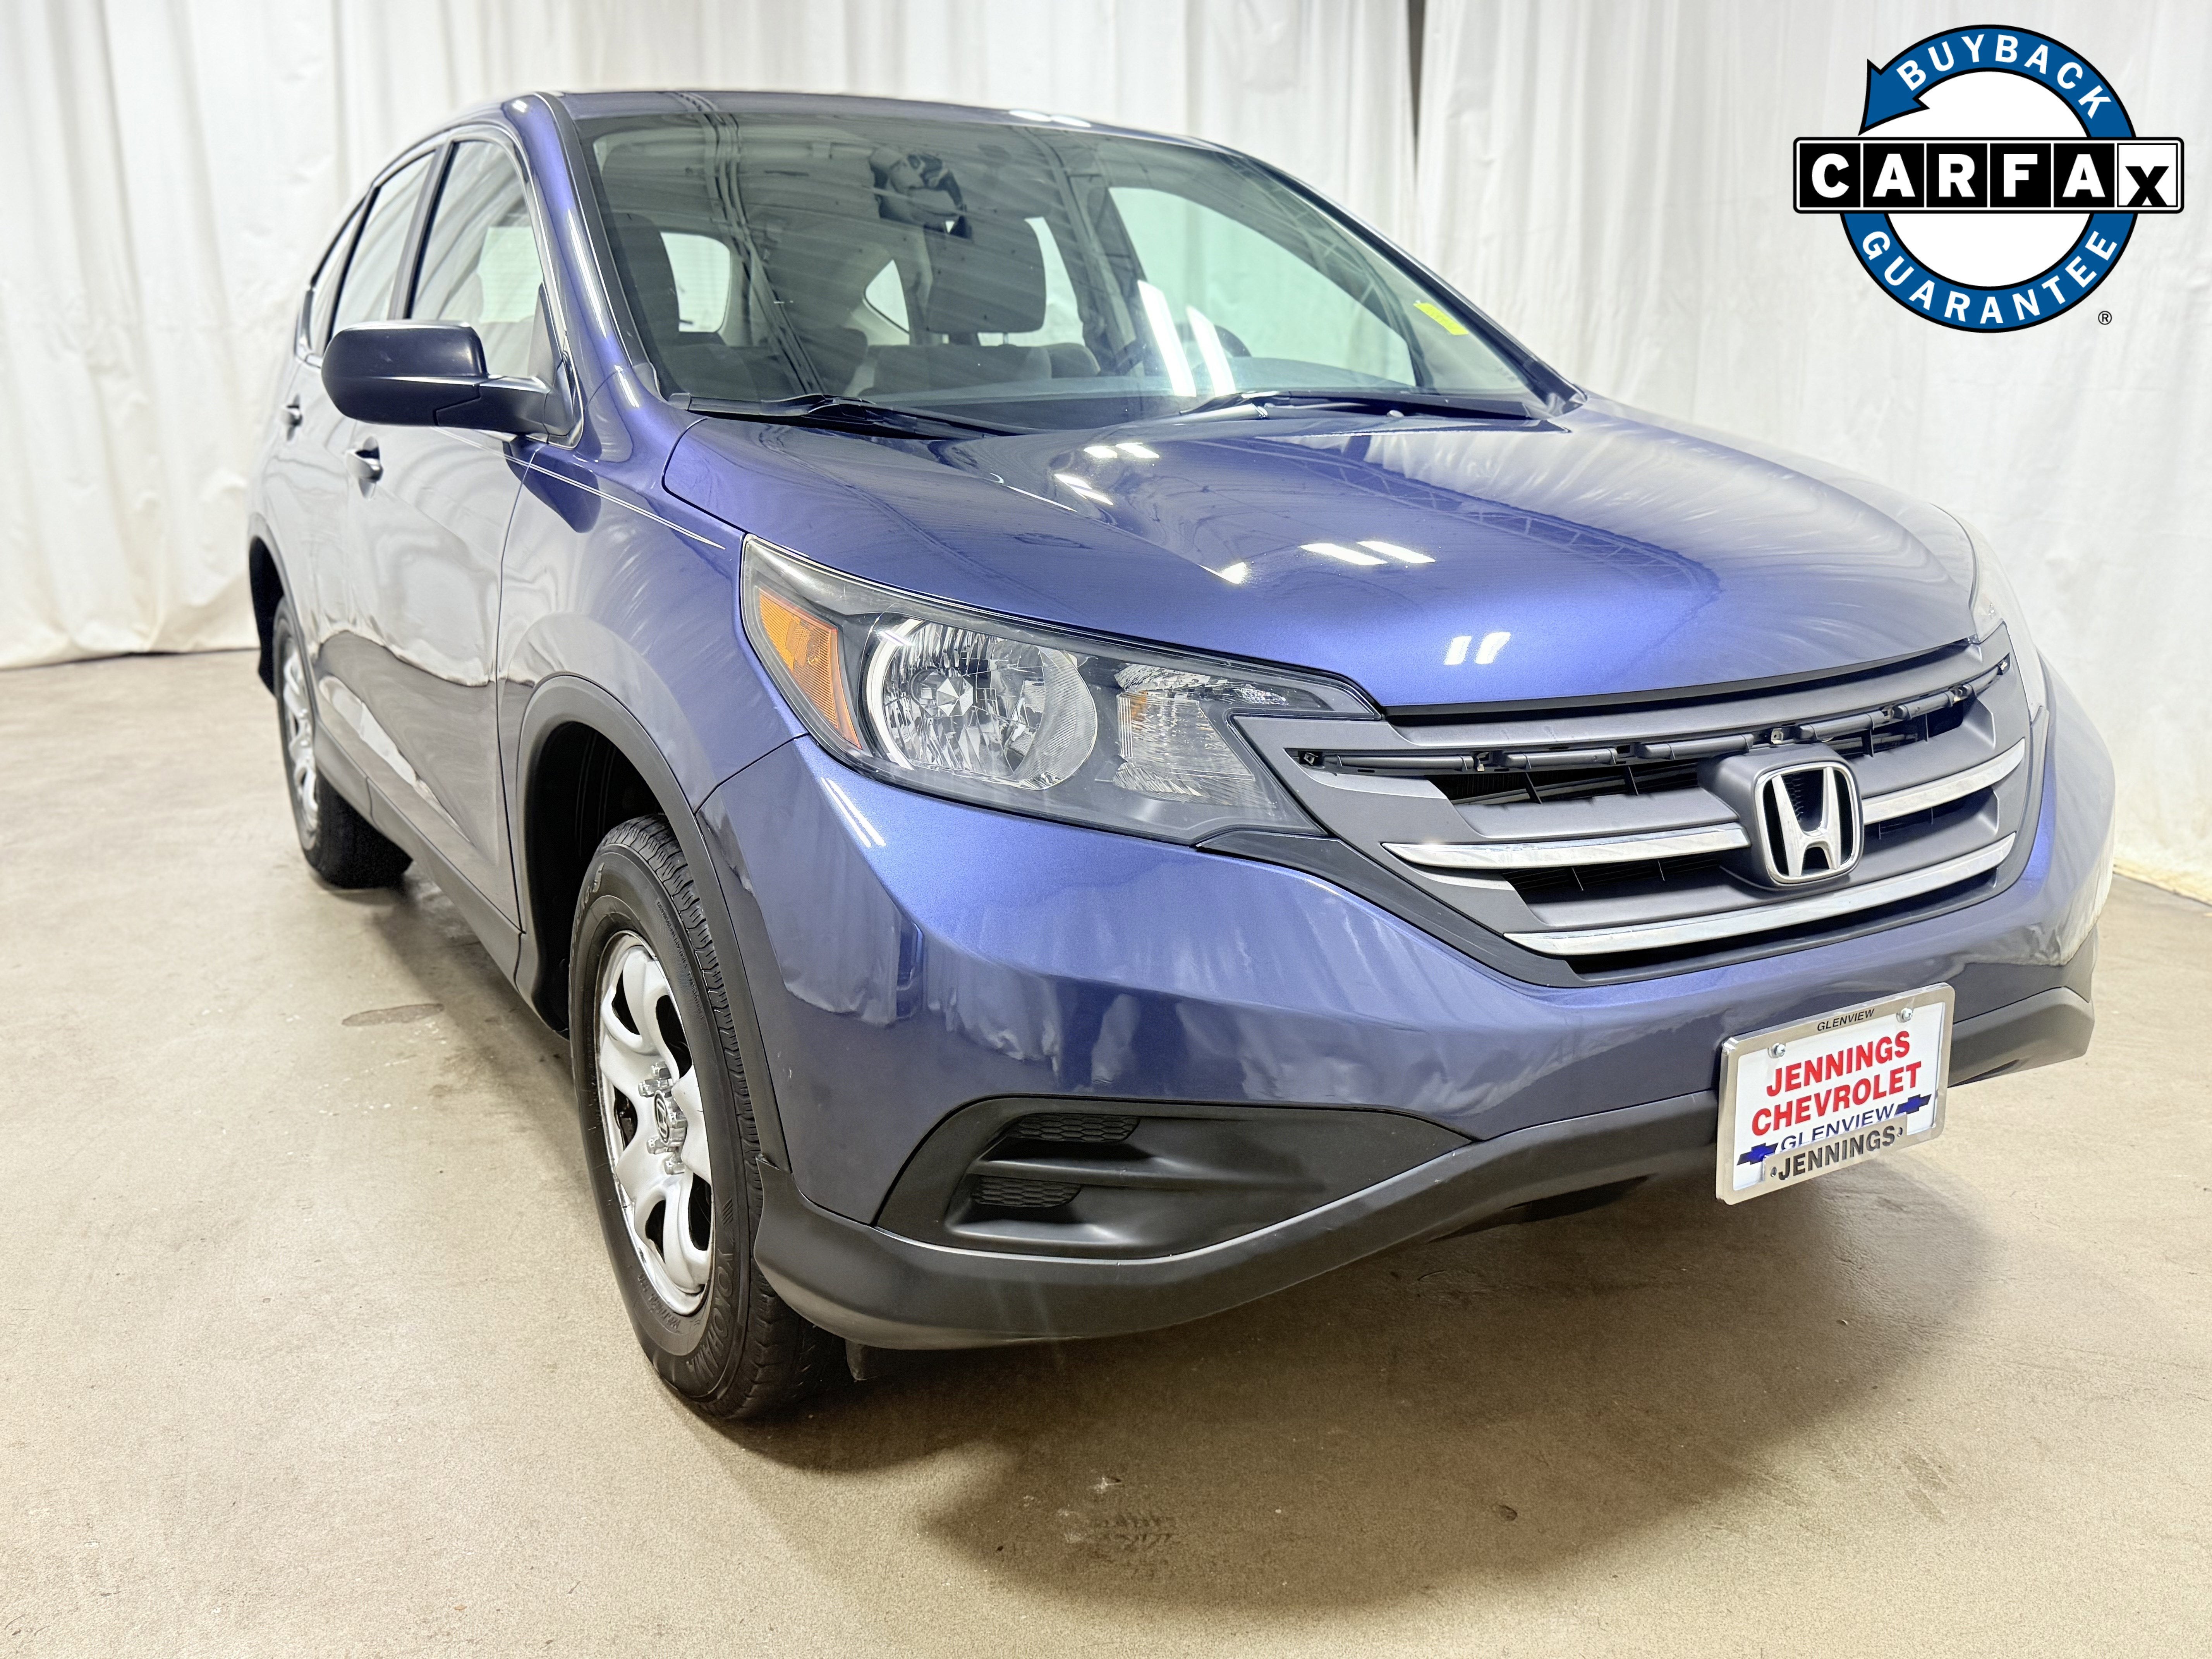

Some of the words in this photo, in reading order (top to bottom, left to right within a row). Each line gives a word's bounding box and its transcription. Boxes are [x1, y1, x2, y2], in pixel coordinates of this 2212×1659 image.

[1817, 1008, 1875, 1031] GLENVIEW
[1766, 1030, 1910, 1097] JENNINGS
[1752, 1061, 1922, 1136] CHEVROLET
[1778, 1126, 1895, 1180] JENNINGS
[1781, 1103, 1894, 1151] GLENVIEW
